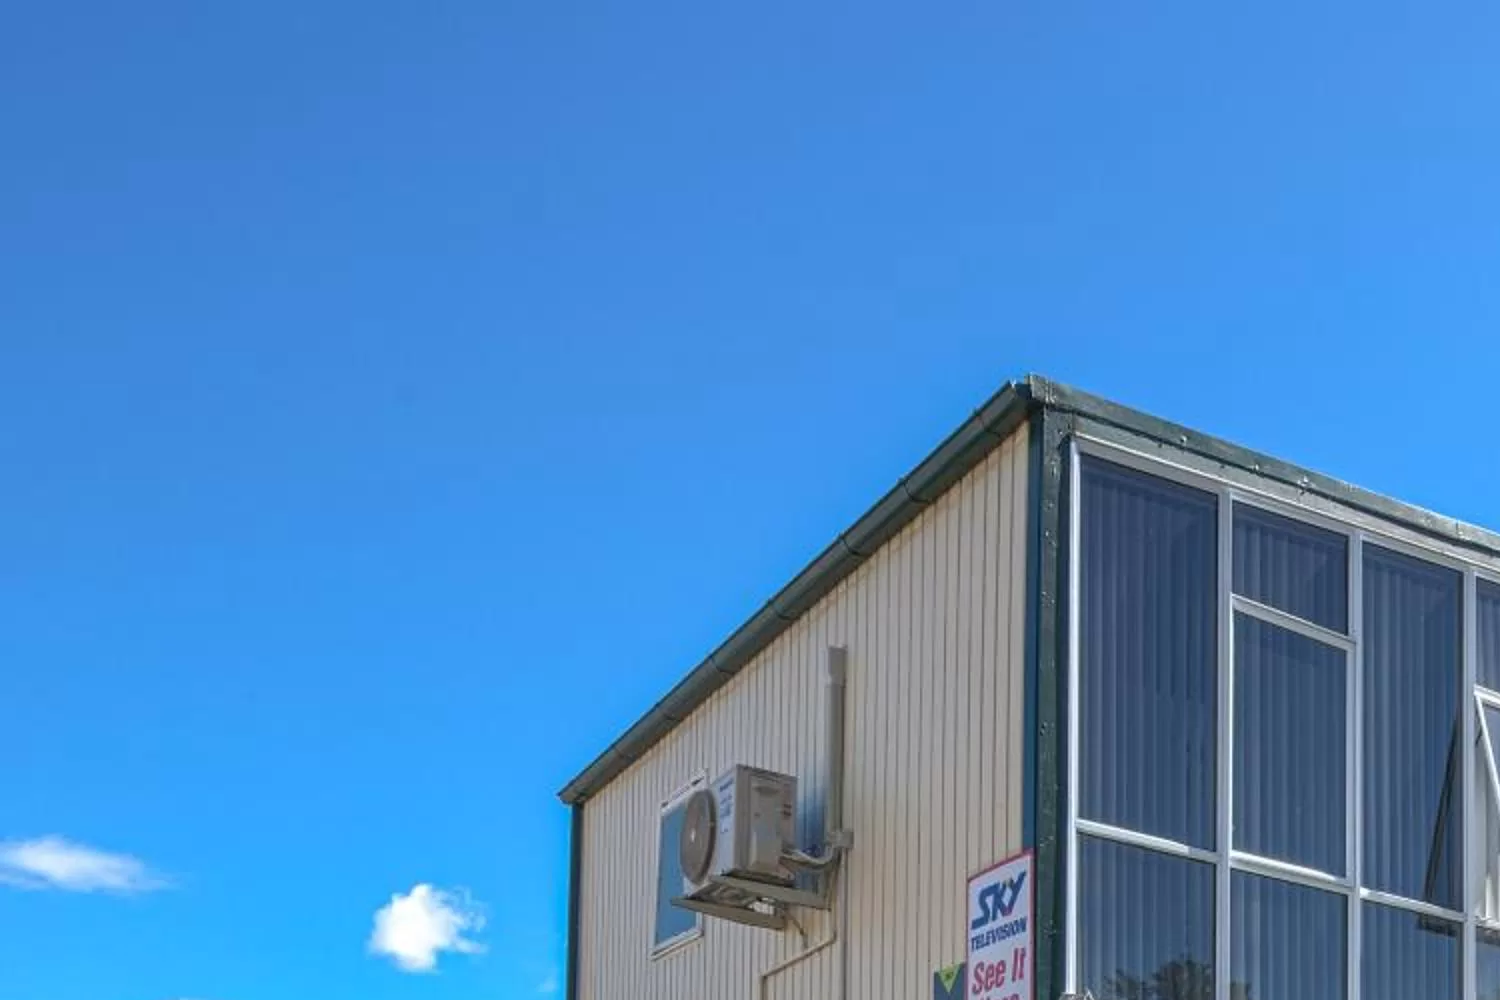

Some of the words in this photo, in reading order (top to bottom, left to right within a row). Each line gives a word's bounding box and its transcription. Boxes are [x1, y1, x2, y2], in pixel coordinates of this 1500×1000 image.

[971, 871, 1027, 930] SKY
[971, 917, 1027, 951] TELEVISION
[972, 959, 1007, 996] See
